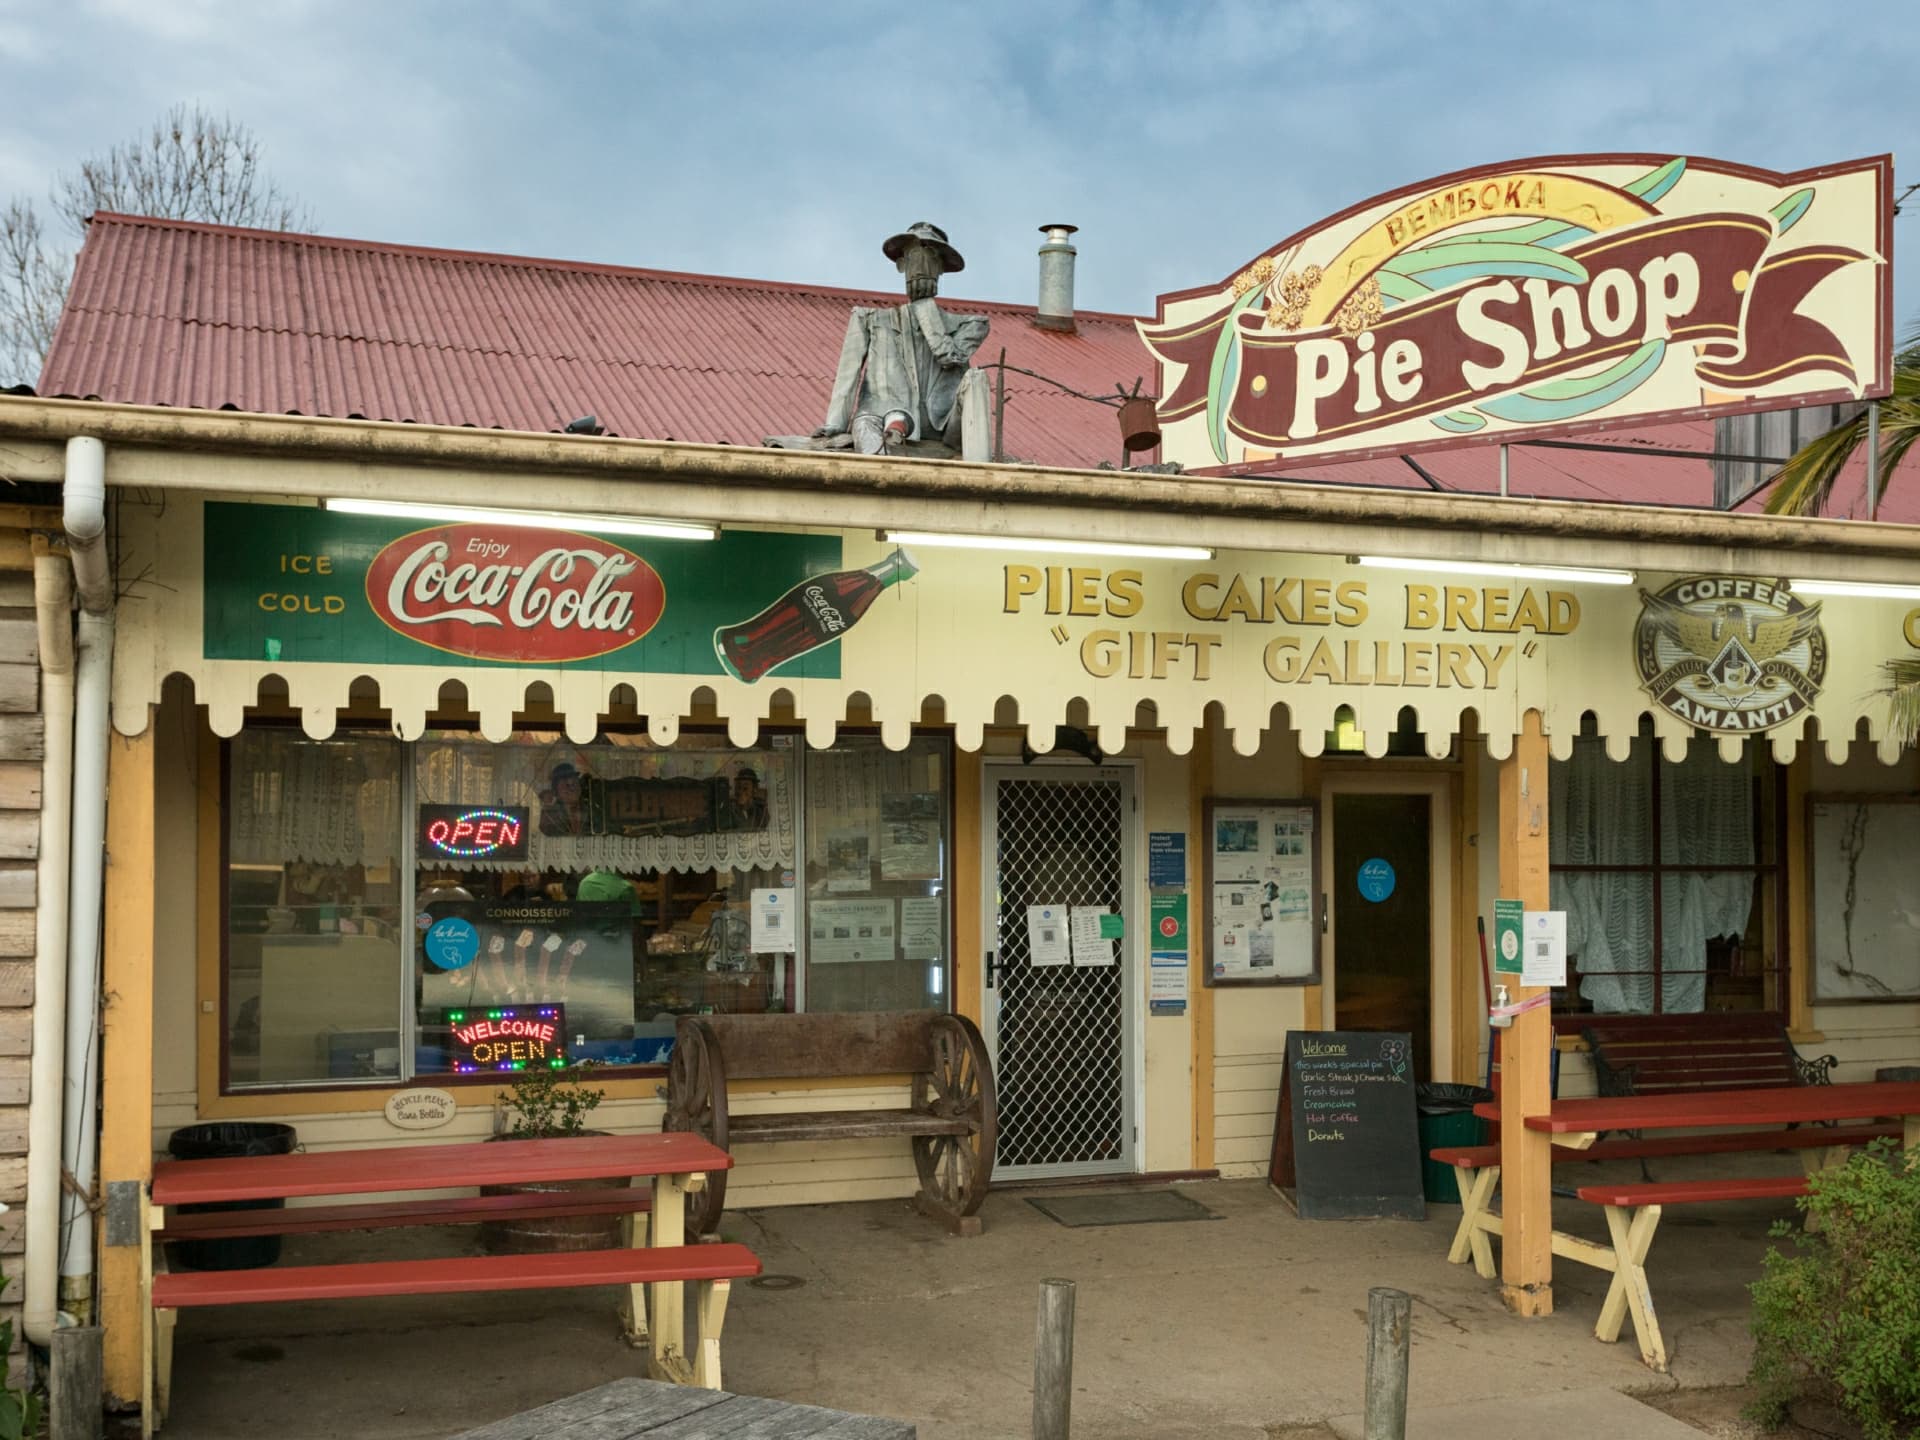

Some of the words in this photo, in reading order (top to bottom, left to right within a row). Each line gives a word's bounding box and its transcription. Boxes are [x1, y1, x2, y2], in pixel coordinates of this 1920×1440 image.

[1384, 178, 1547, 248] BEMBOKA
[1288, 331, 1424, 440] Pie
[1456, 251, 1701, 392] Shop
[466, 537, 510, 559] Enjoy
[280, 554, 333, 575] ICE
[387, 540, 638, 630] Coca-Cola
[1676, 579, 1792, 612] COFFEE
[257, 591, 345, 614] COLD
[1003, 564, 1145, 618] PIES
[1181, 572, 1369, 627] CAKES
[1403, 583, 1582, 635] BREAD
[1653, 662, 1707, 694] PREMIUM
[1765, 663, 1817, 698] QUALITY
[1669, 698, 1795, 730] AMANTI
[428, 820, 521, 845] OPEN
[486, 907, 571, 918] CONNOISSEUR
[457, 1019, 555, 1044] WELCOME
[472, 1040, 545, 1062] OPEN
[1301, 1040, 1348, 1055] Welcome
[1340, 1059, 1370, 1071] special
[1301, 1071, 1326, 1082] Garlic
[1304, 1085, 1328, 1096] Fresh
[1329, 1086, 1355, 1096] Bread
[1303, 1099, 1357, 1110] Creamcakes
[1306, 1113, 1326, 1123] Hot
[1329, 1113, 1360, 1123] Coffee
[1308, 1128, 1345, 1142] Donuts
